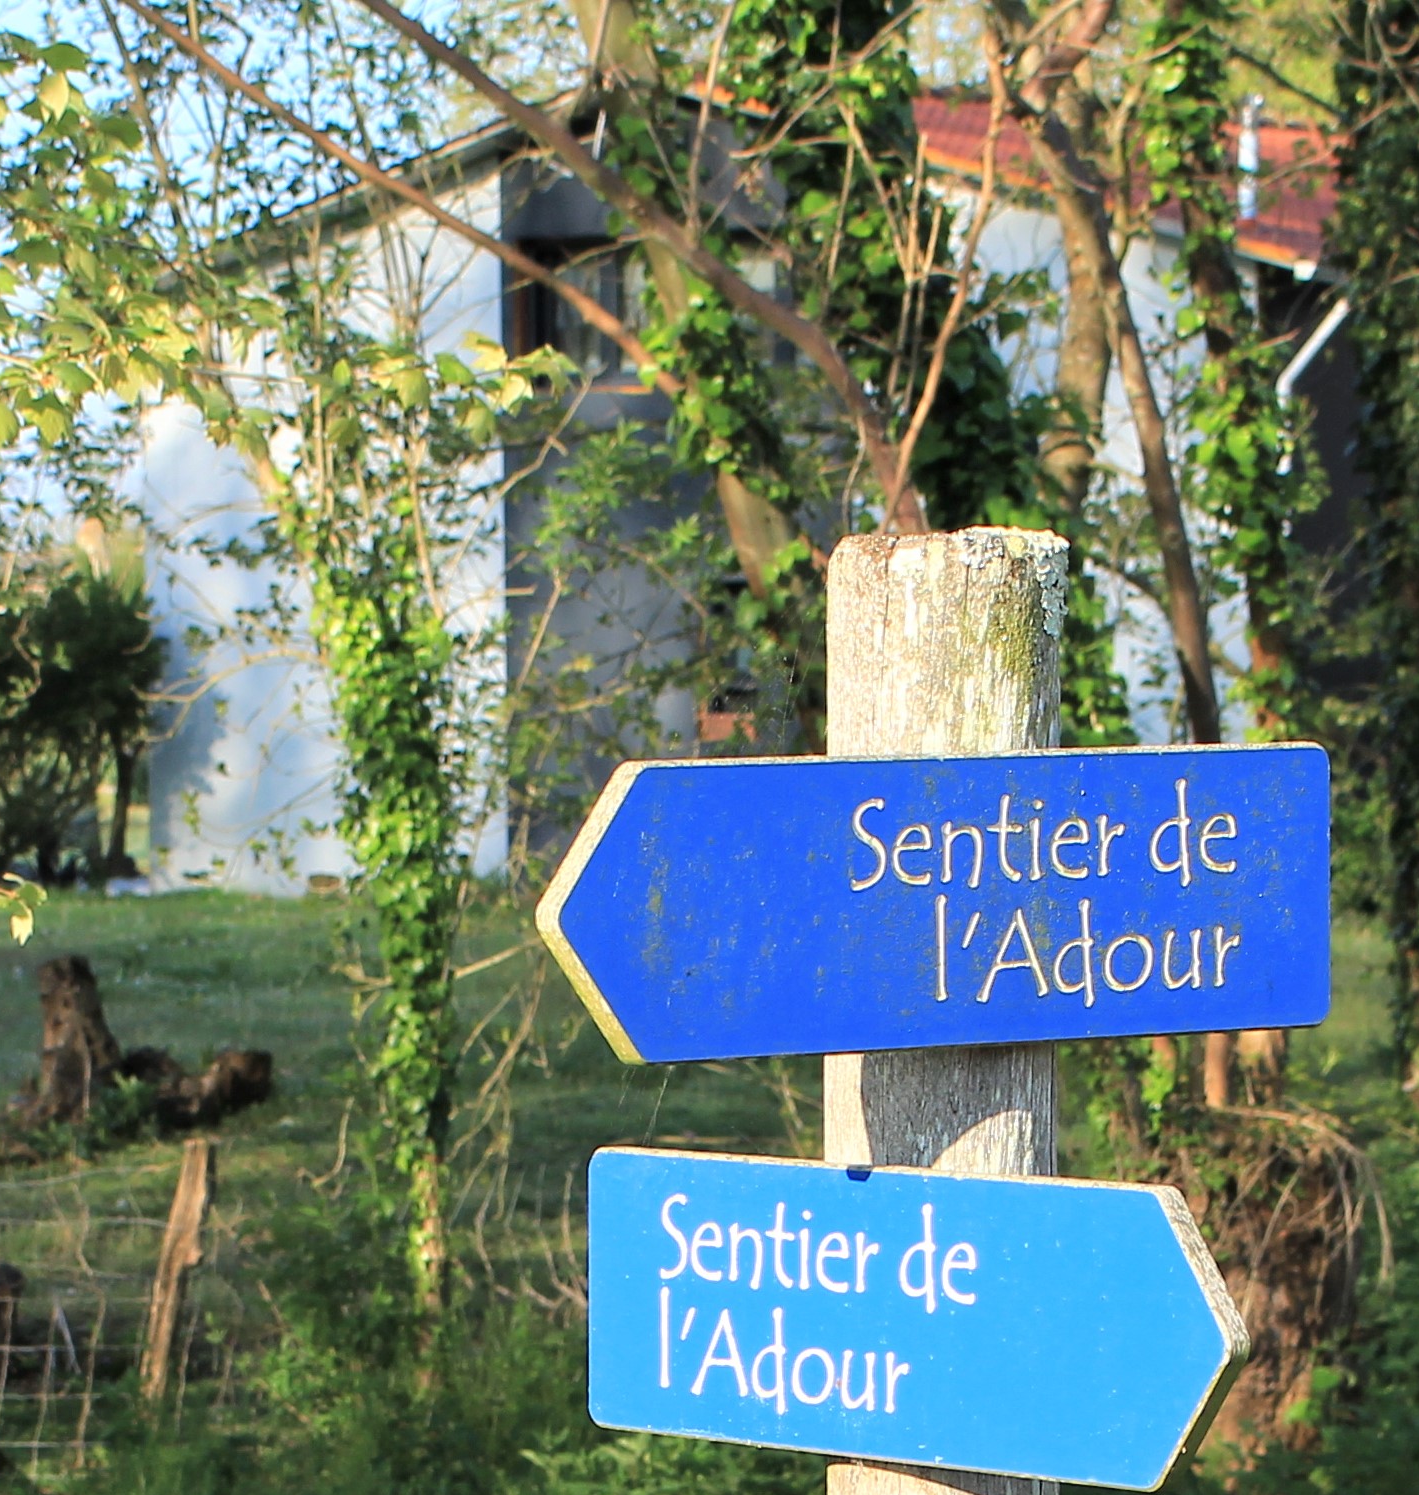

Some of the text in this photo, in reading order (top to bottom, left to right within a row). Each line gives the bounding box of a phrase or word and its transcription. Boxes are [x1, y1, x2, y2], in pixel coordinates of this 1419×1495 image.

[849, 777, 1237, 892] Sentier de
[934, 893, 1242, 1008] l'Adour
[659, 1192, 979, 1313] Sentier de
[659, 1286, 910, 1414] l'Adour
